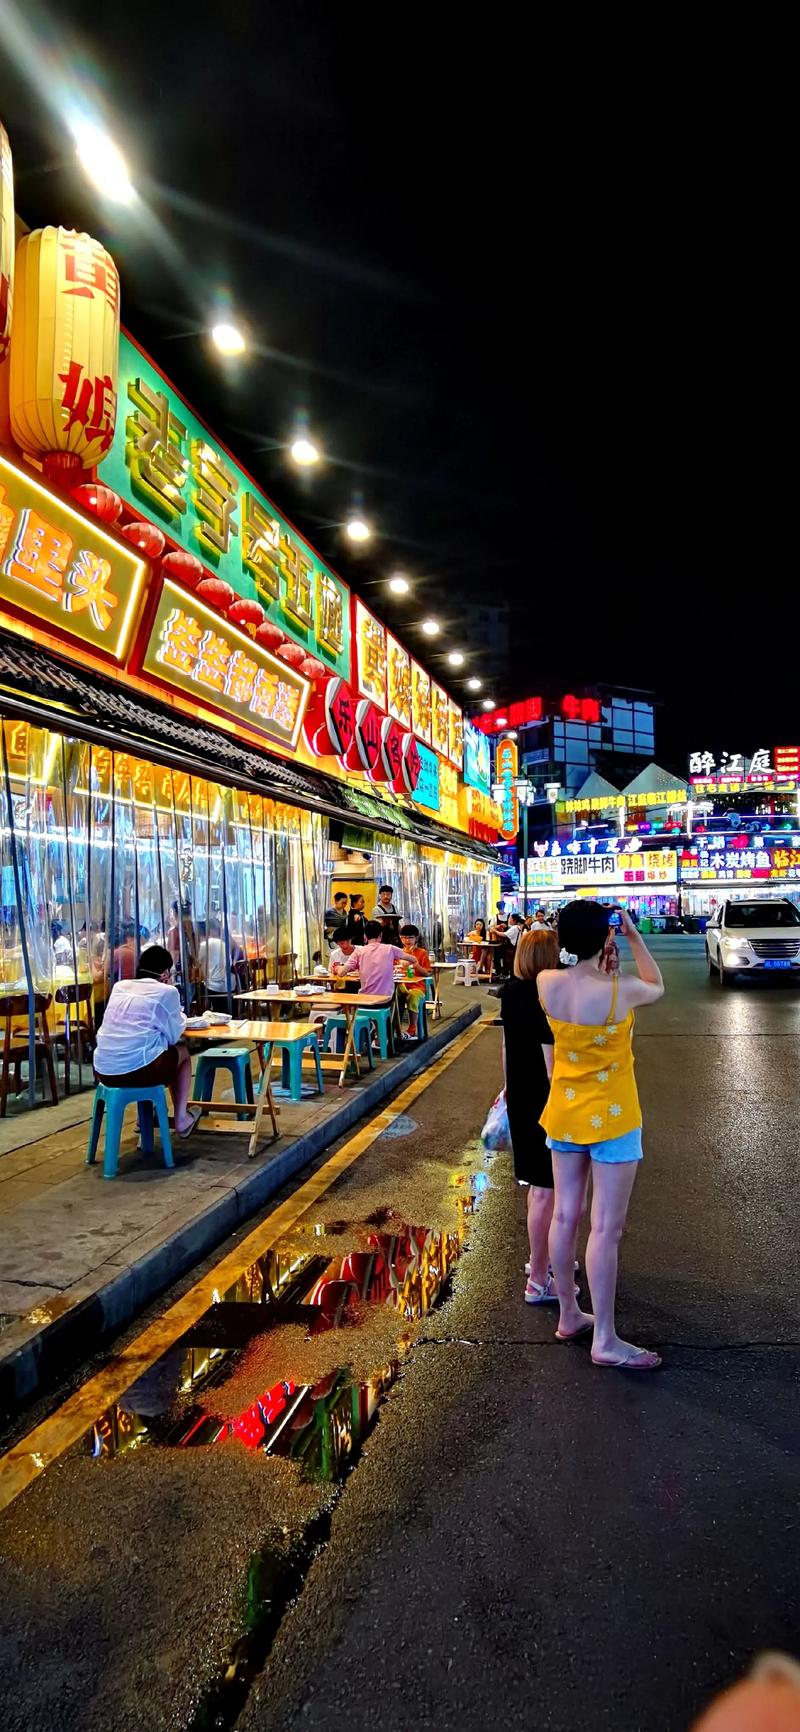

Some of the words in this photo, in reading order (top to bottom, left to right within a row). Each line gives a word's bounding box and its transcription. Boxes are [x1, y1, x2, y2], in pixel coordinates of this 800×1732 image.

[690, 749, 776, 776] 醉江庭
[561, 856, 615, 876] 跷脚牛肉
[710, 850, 772, 869] 木炭烤鱼
